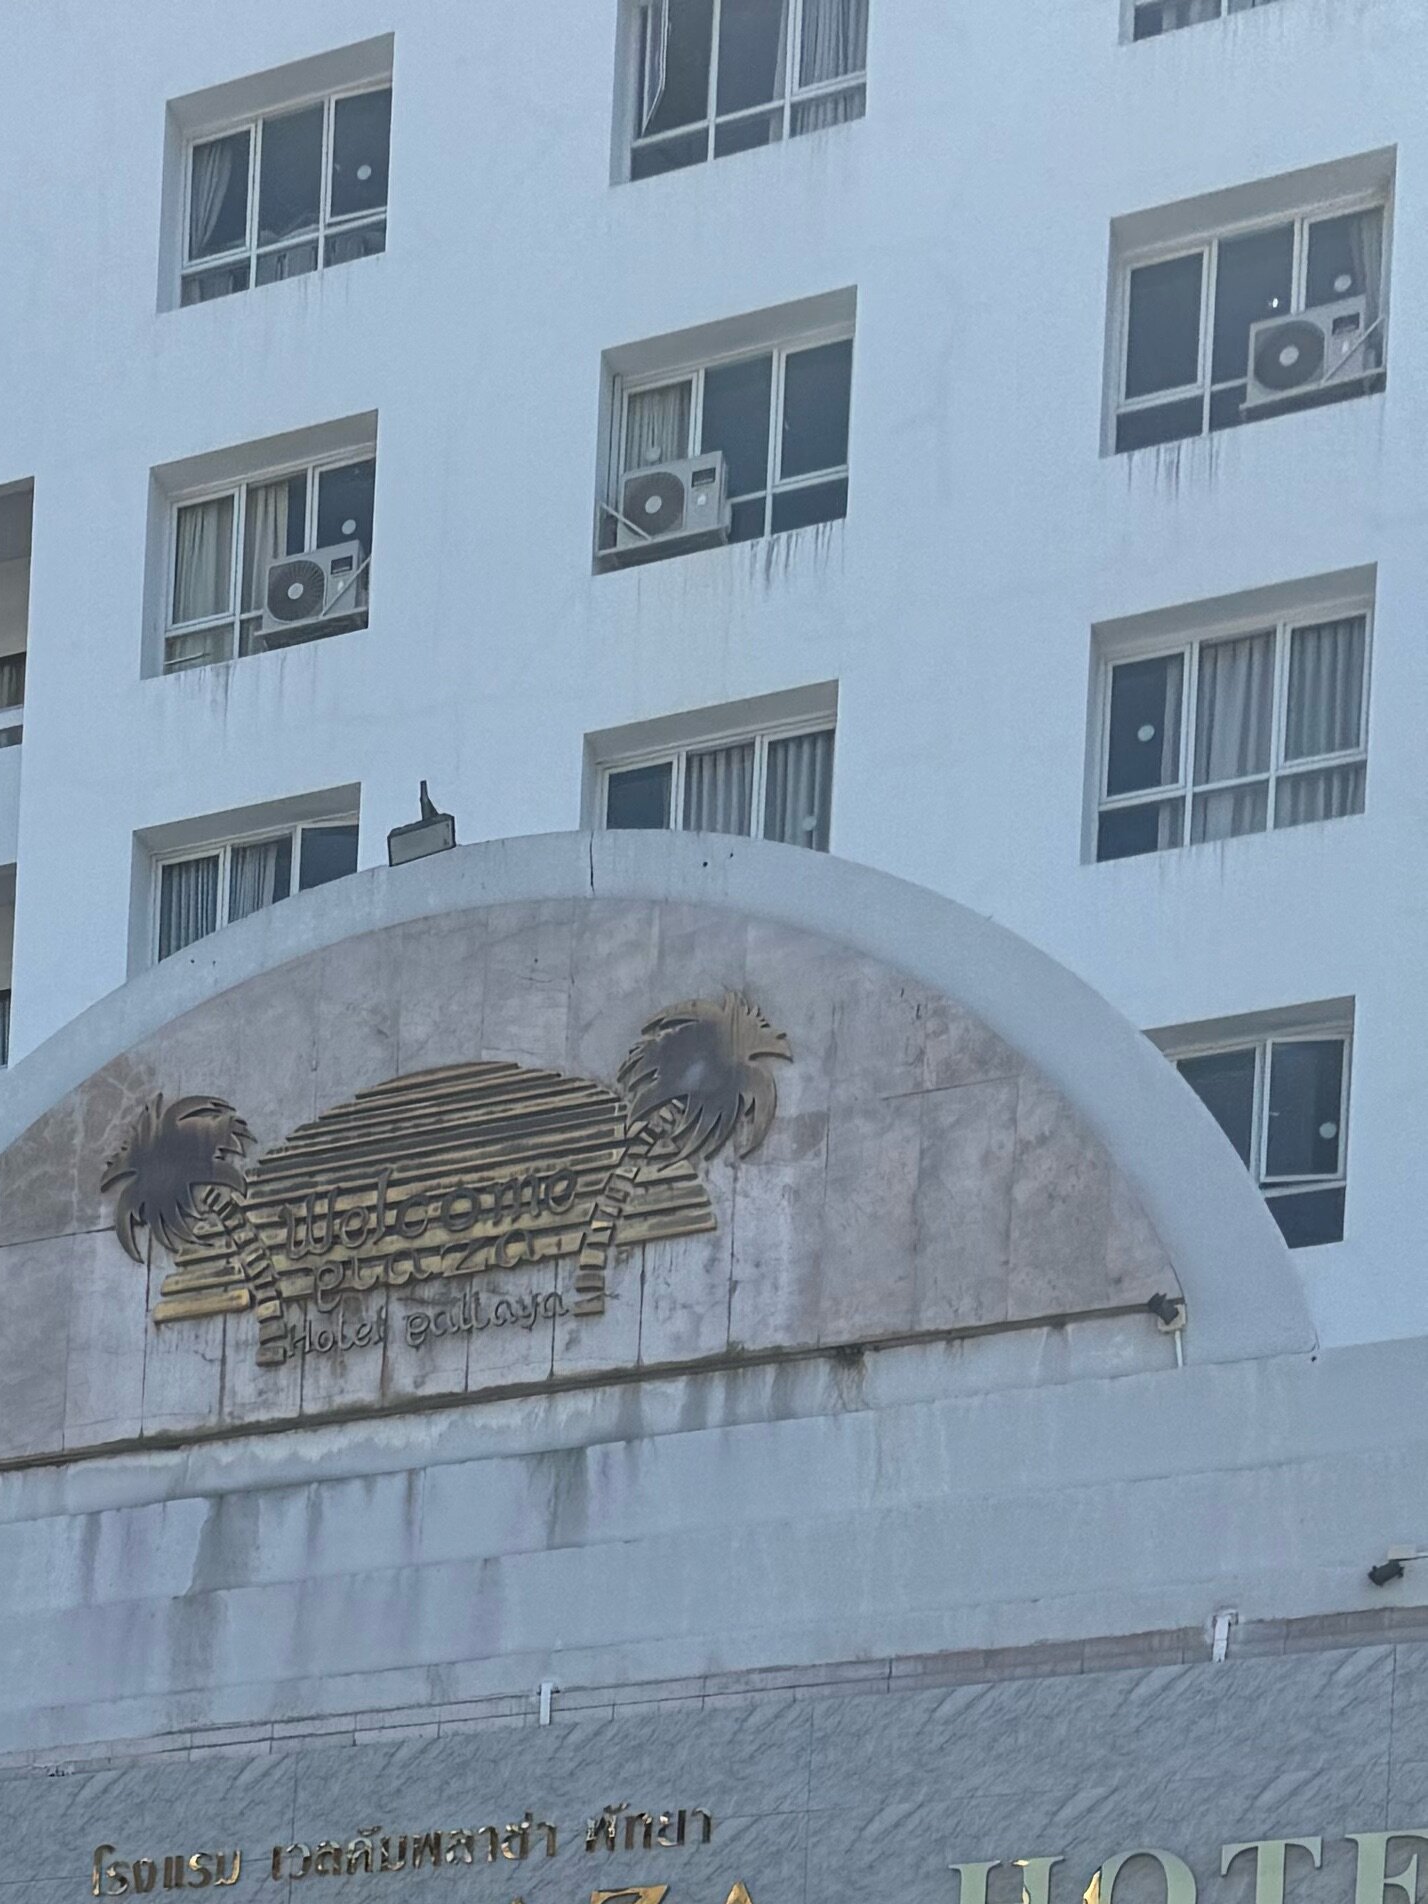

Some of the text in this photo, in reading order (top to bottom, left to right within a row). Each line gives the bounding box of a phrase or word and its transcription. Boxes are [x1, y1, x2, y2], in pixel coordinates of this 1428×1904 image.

[278, 1167, 578, 1261] Welcome
[287, 1303, 388, 1358] Hotel
[91, 1843, 241, 1898] โรงแรม
[585, 1802, 713, 1854] พัทยา
